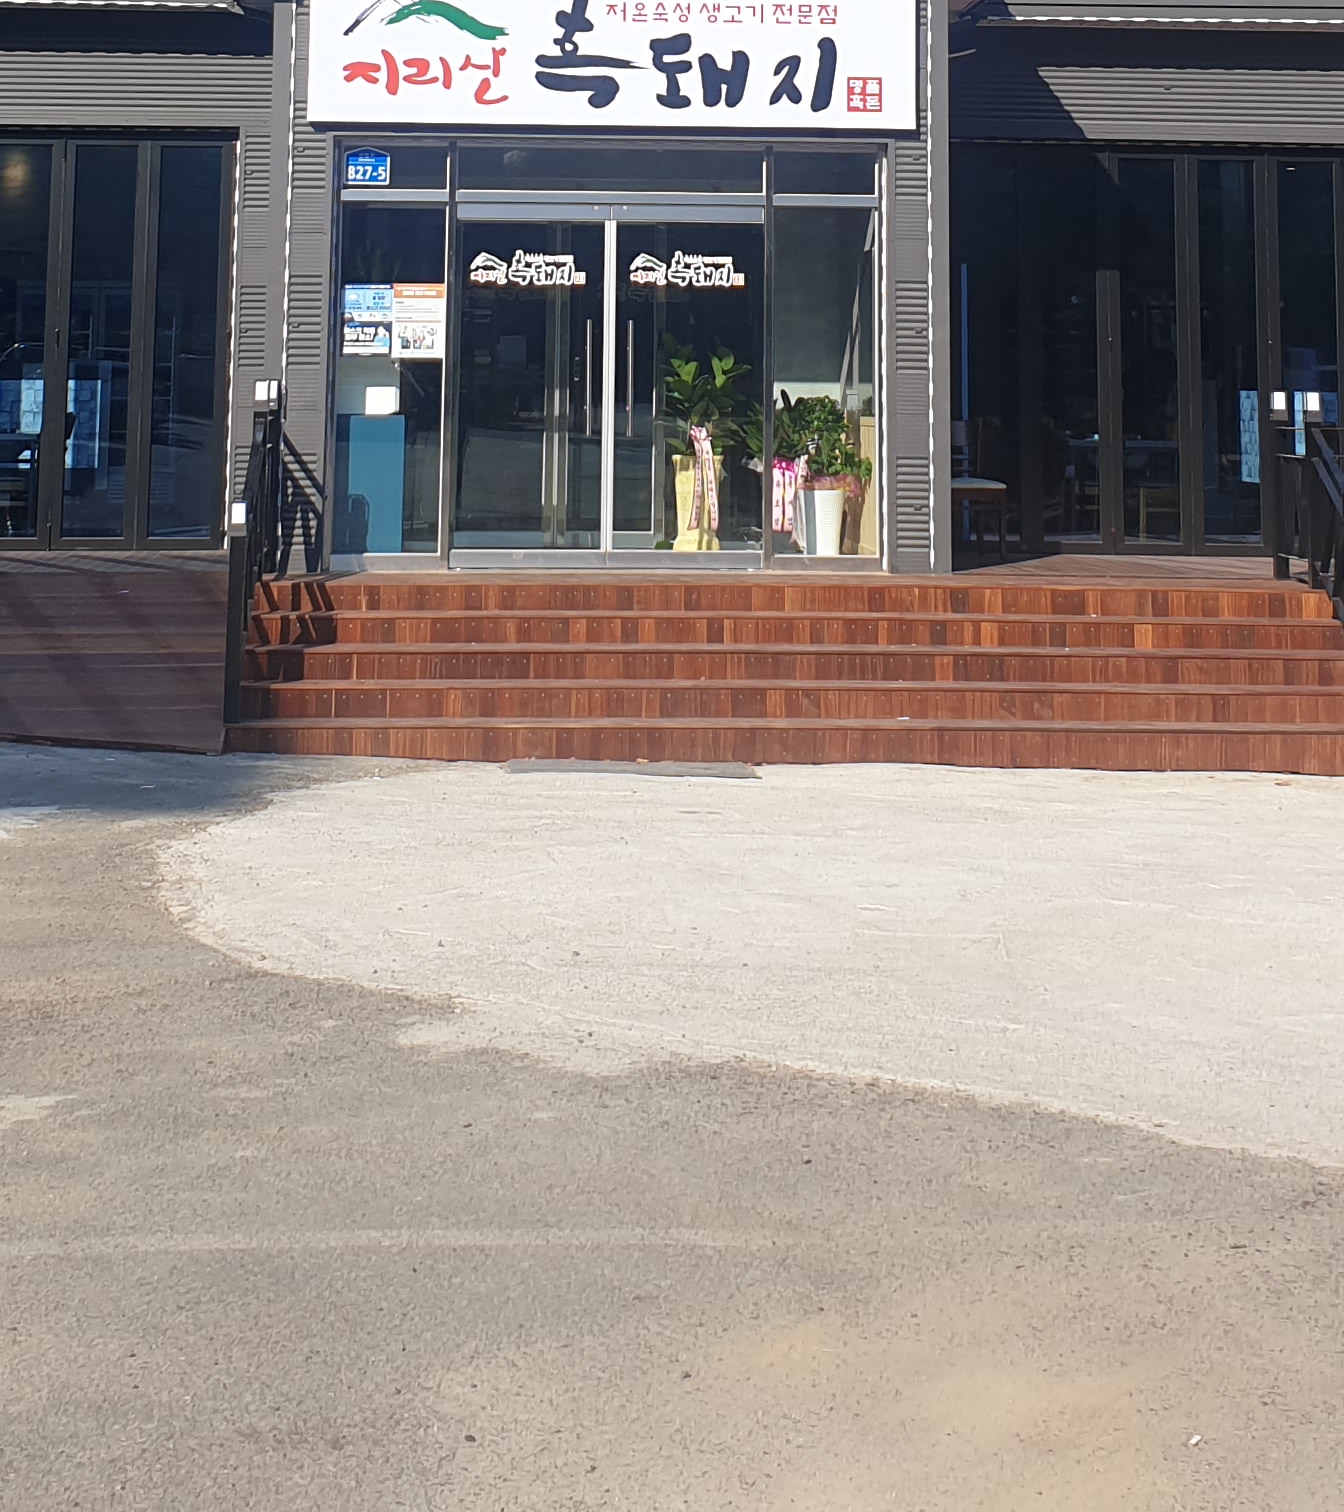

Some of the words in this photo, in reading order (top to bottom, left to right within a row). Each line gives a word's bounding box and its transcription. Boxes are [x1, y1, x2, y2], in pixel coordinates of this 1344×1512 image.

[605, 1, 691, 23] 저온숙성
[699, 2, 765, 24] 생고기
[771, 3, 838, 25] 전문점
[342, 46, 510, 106] 지리산
[347, 165, 386, 180] 827-5
